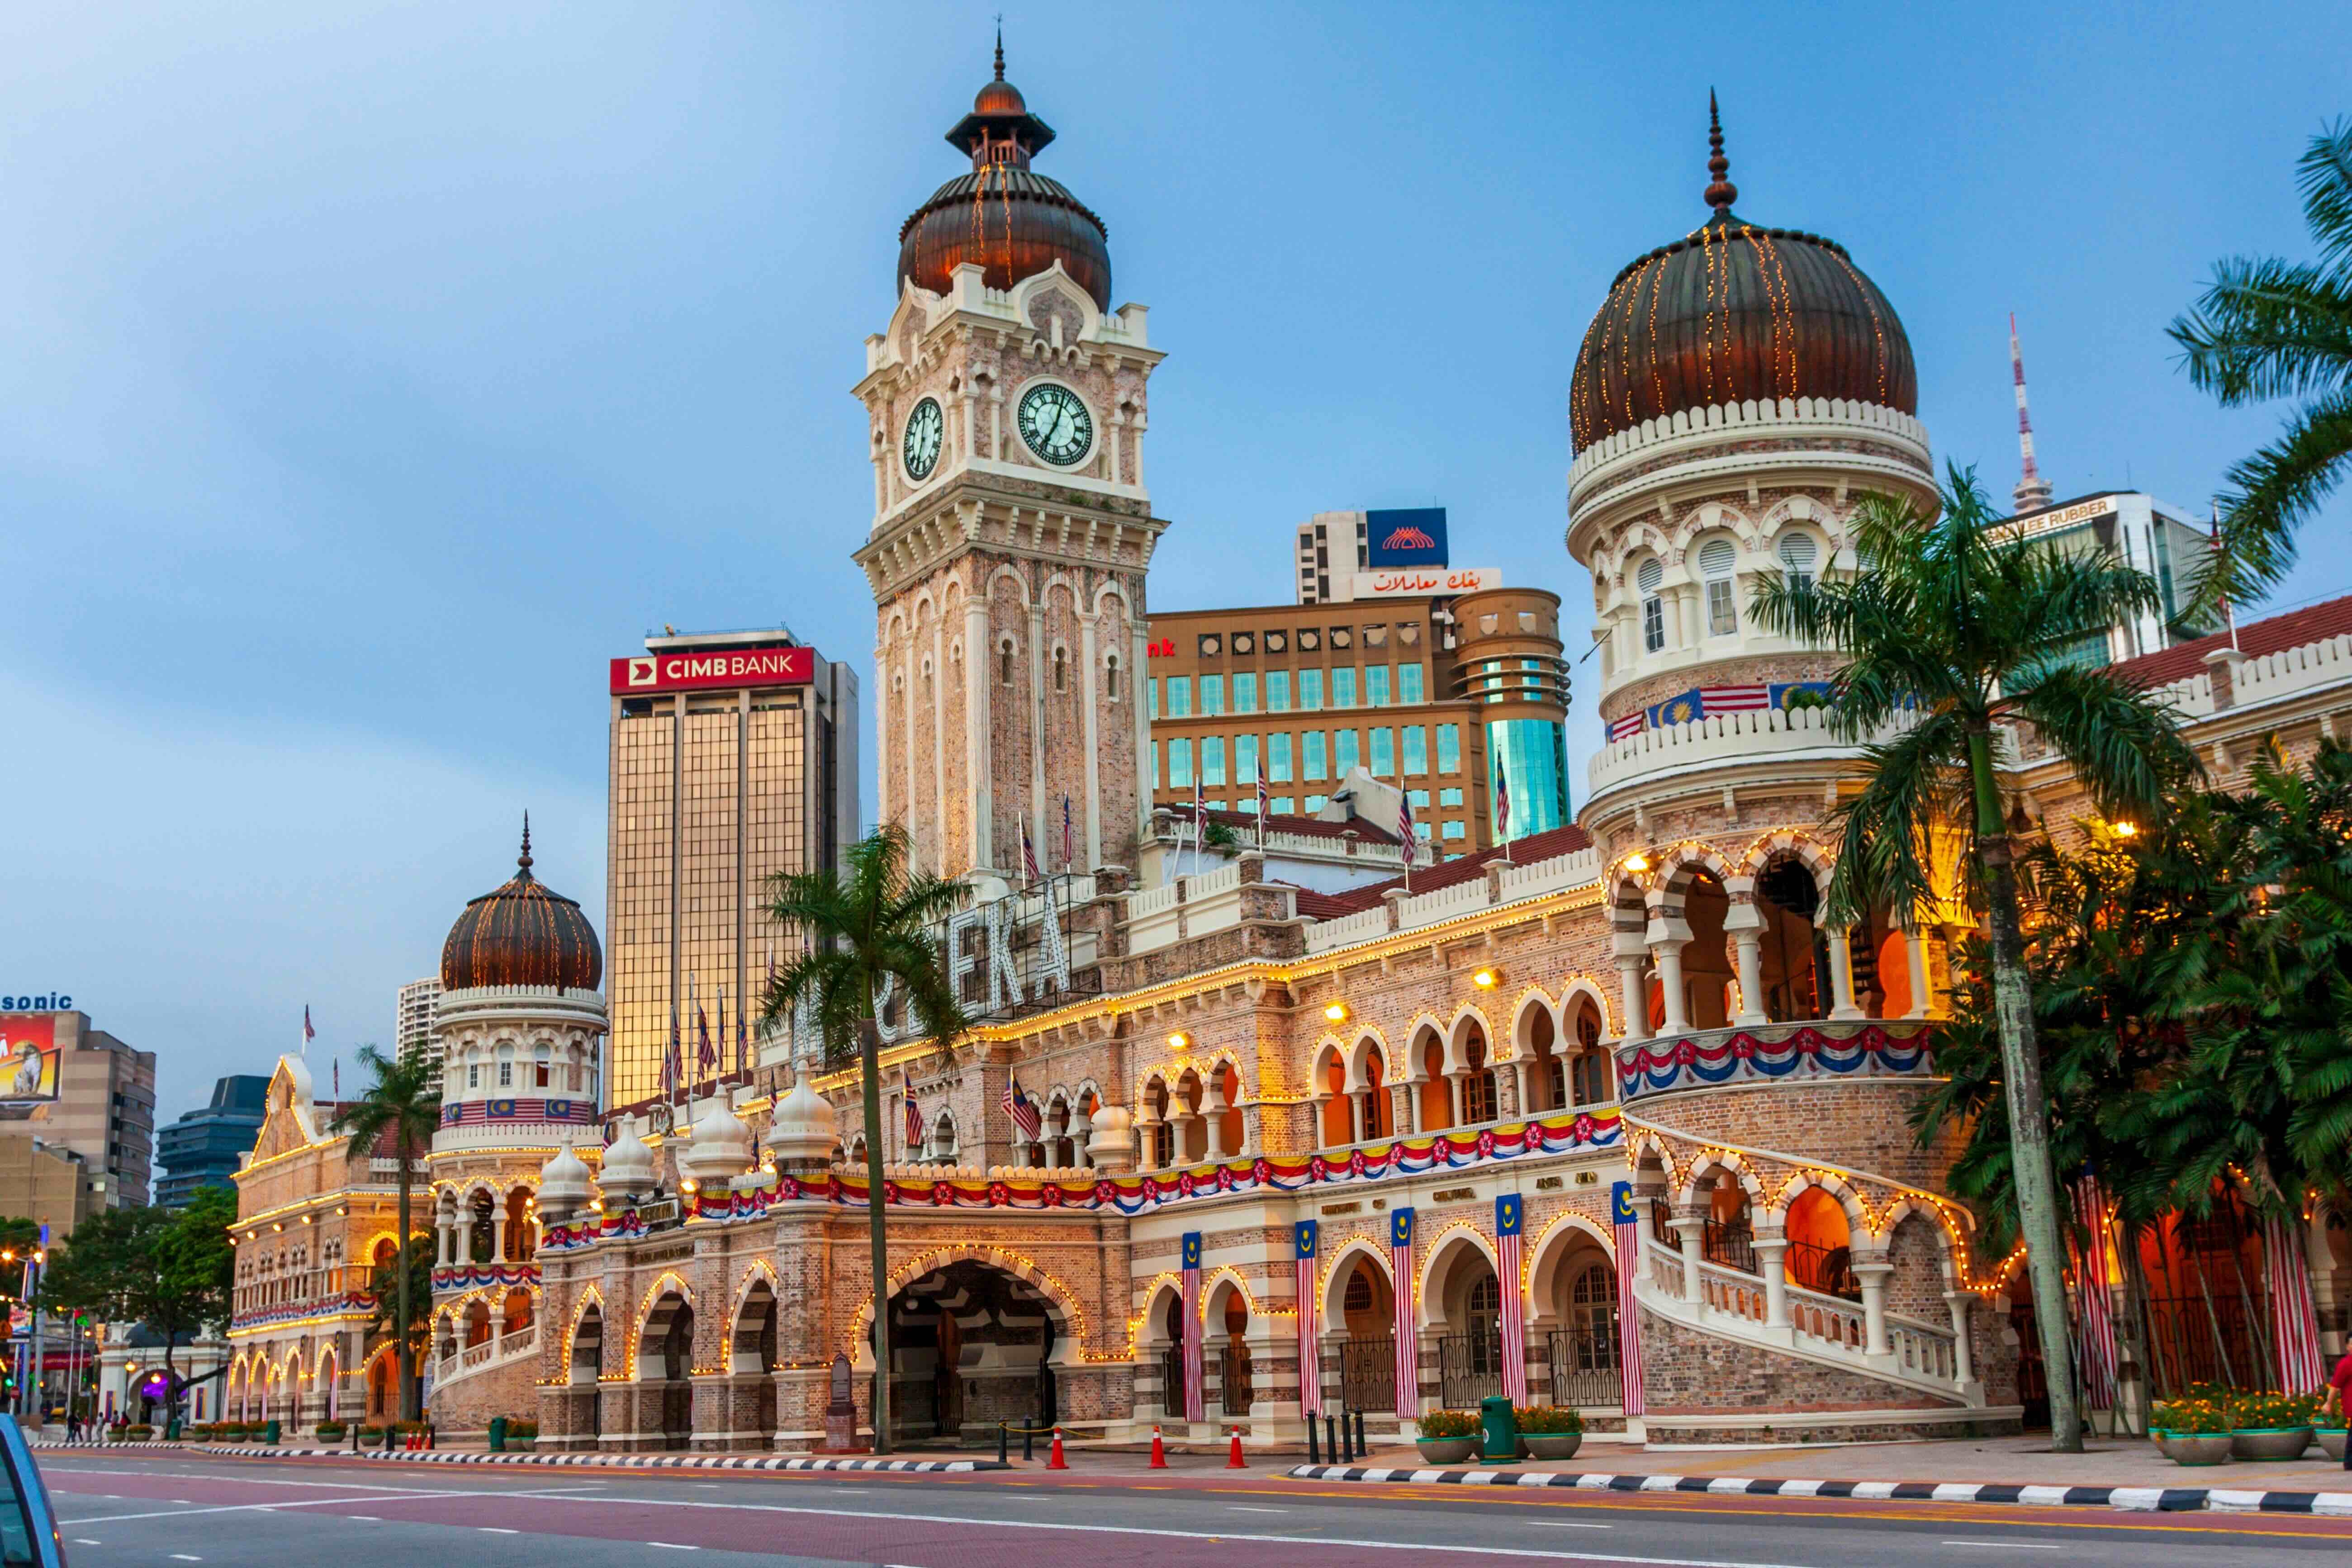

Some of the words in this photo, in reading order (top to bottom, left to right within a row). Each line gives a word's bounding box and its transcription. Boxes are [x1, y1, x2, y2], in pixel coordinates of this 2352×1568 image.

[2049, 501, 2108, 526] RUBBER
[666, 658, 727, 678] CIMB
[732, 654, 793, 675] BANK
[1, 991, 72, 1010] sonic
